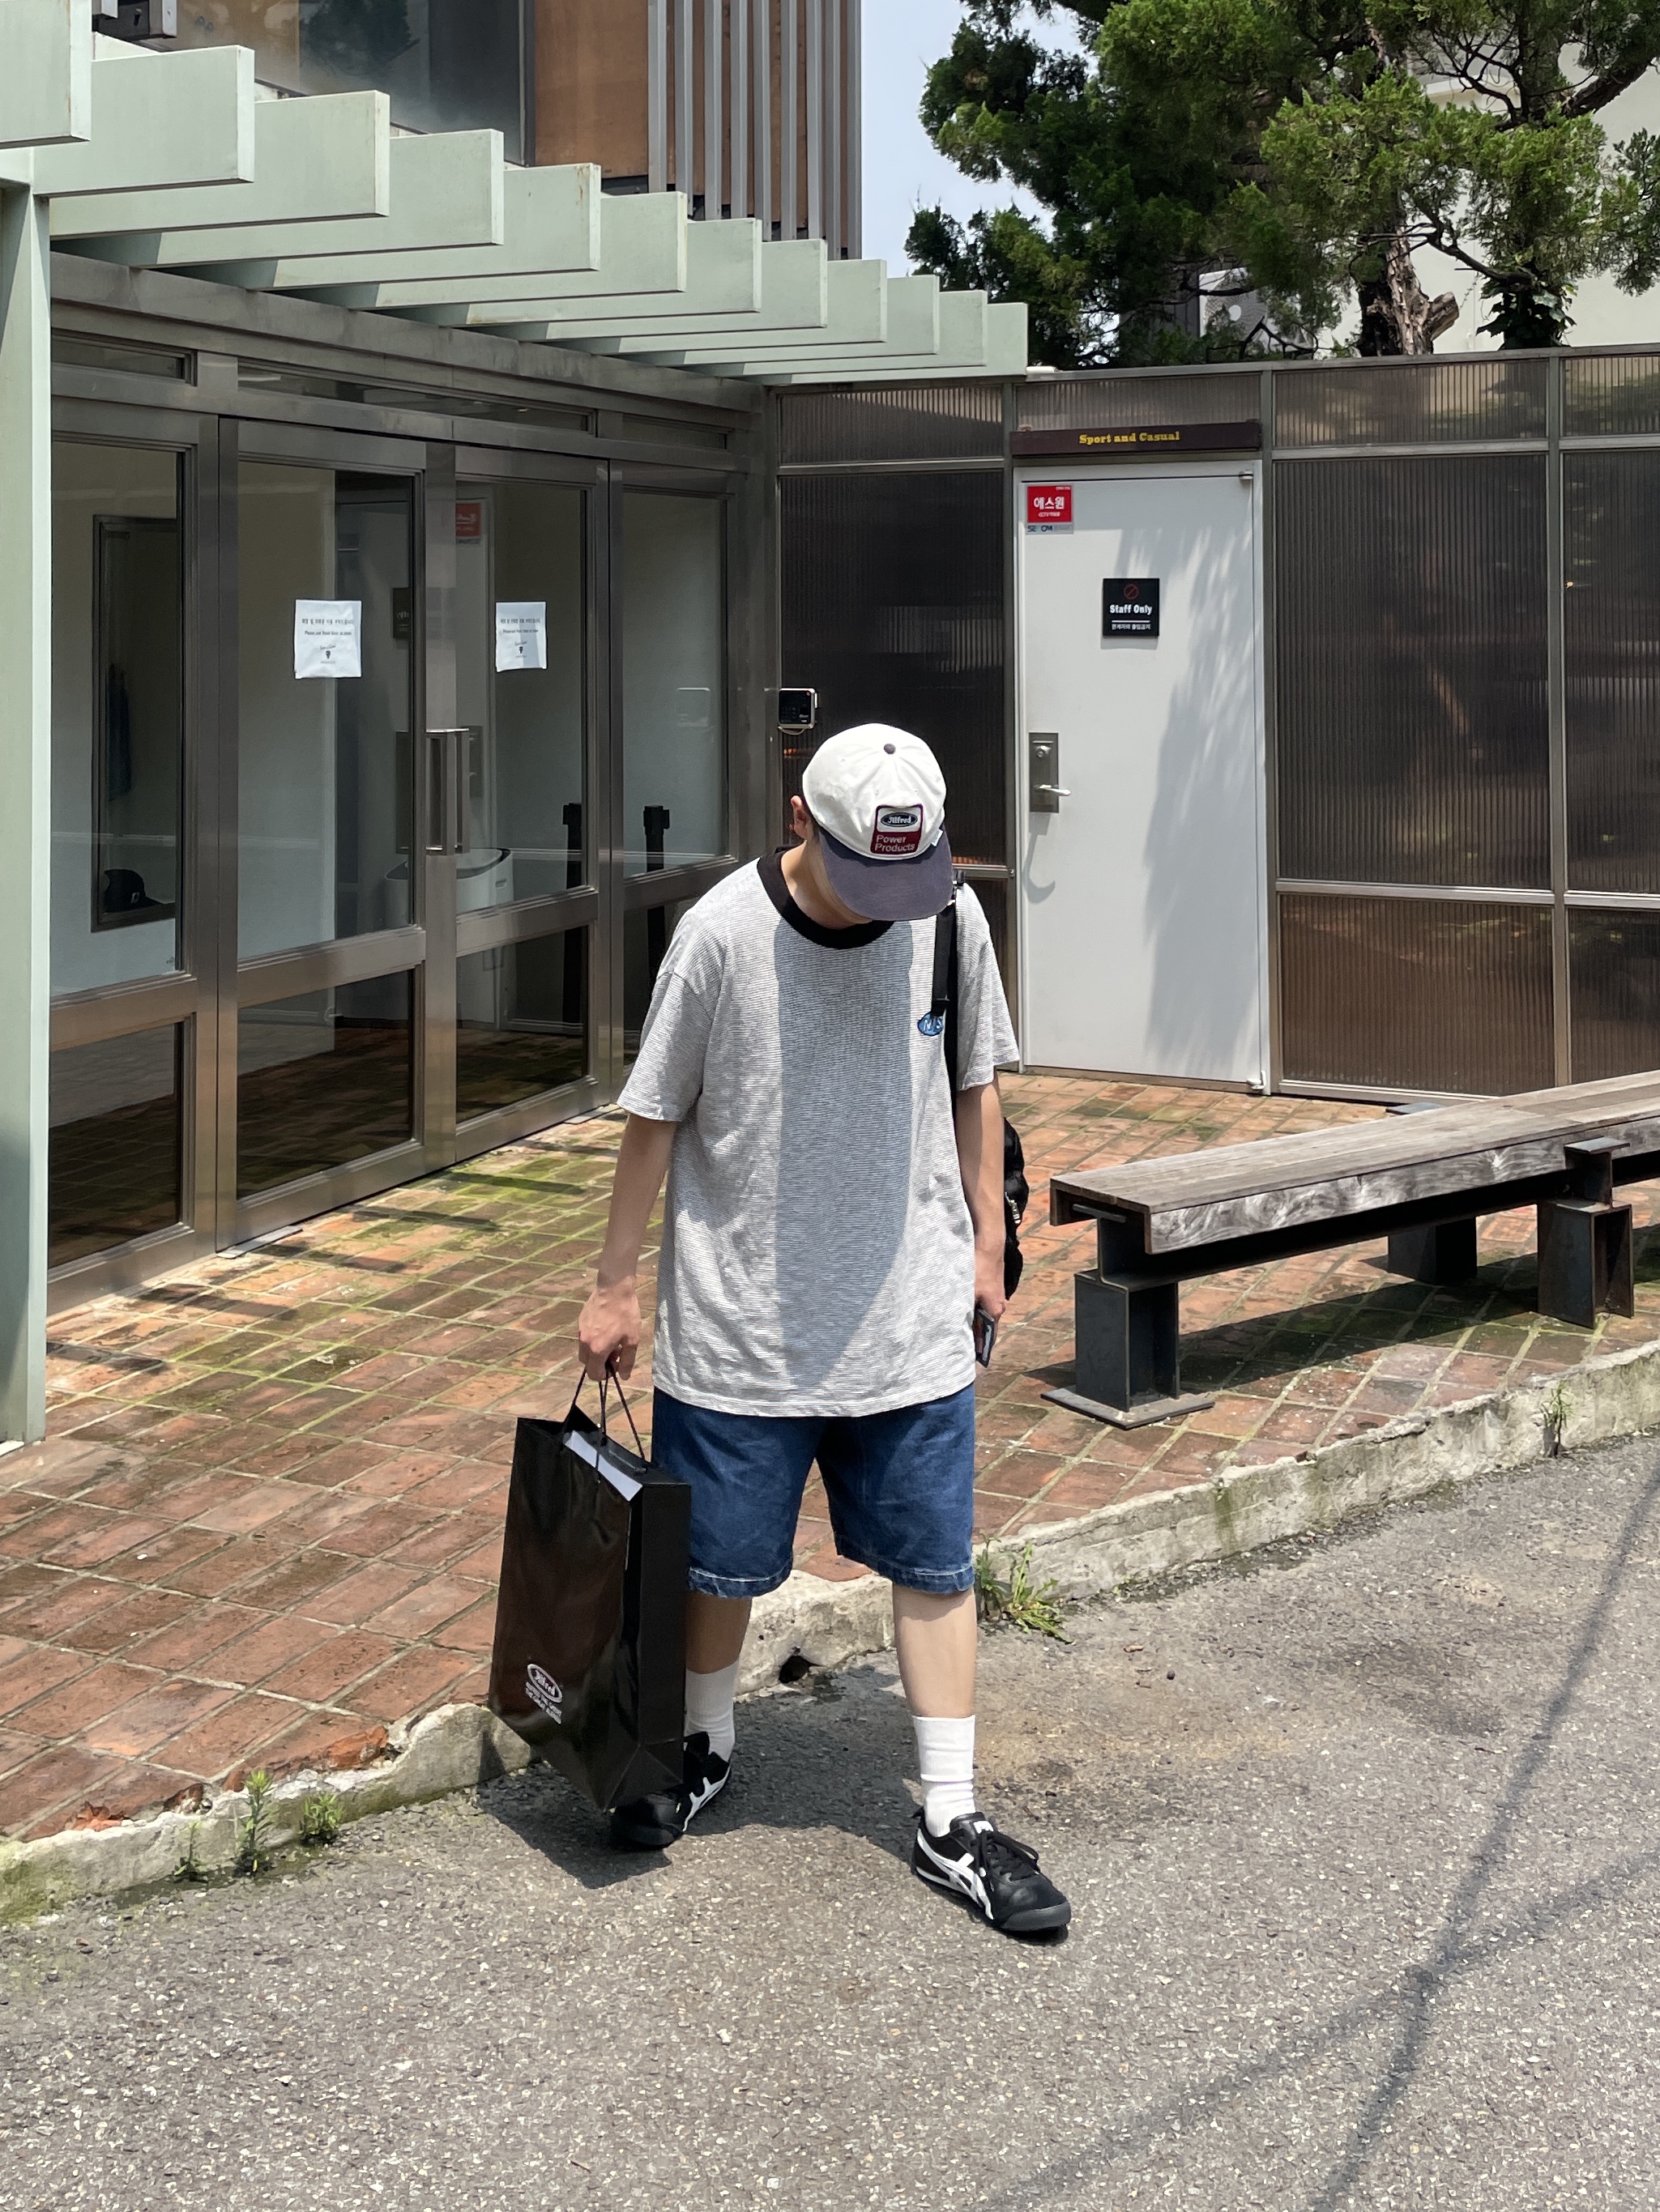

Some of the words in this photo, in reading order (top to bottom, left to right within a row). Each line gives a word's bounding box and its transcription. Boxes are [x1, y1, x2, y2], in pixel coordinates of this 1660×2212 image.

[1079, 434, 1112, 445] Sport
[1114, 433, 1136, 442] and
[1139, 431, 1180, 441] Casual
[1033, 497, 1065, 509] 에스원
[1110, 604, 1132, 613] Staff
[1133, 604, 1152, 616] Only
[876, 835, 907, 843] Power
[875, 843, 915, 852] Products
